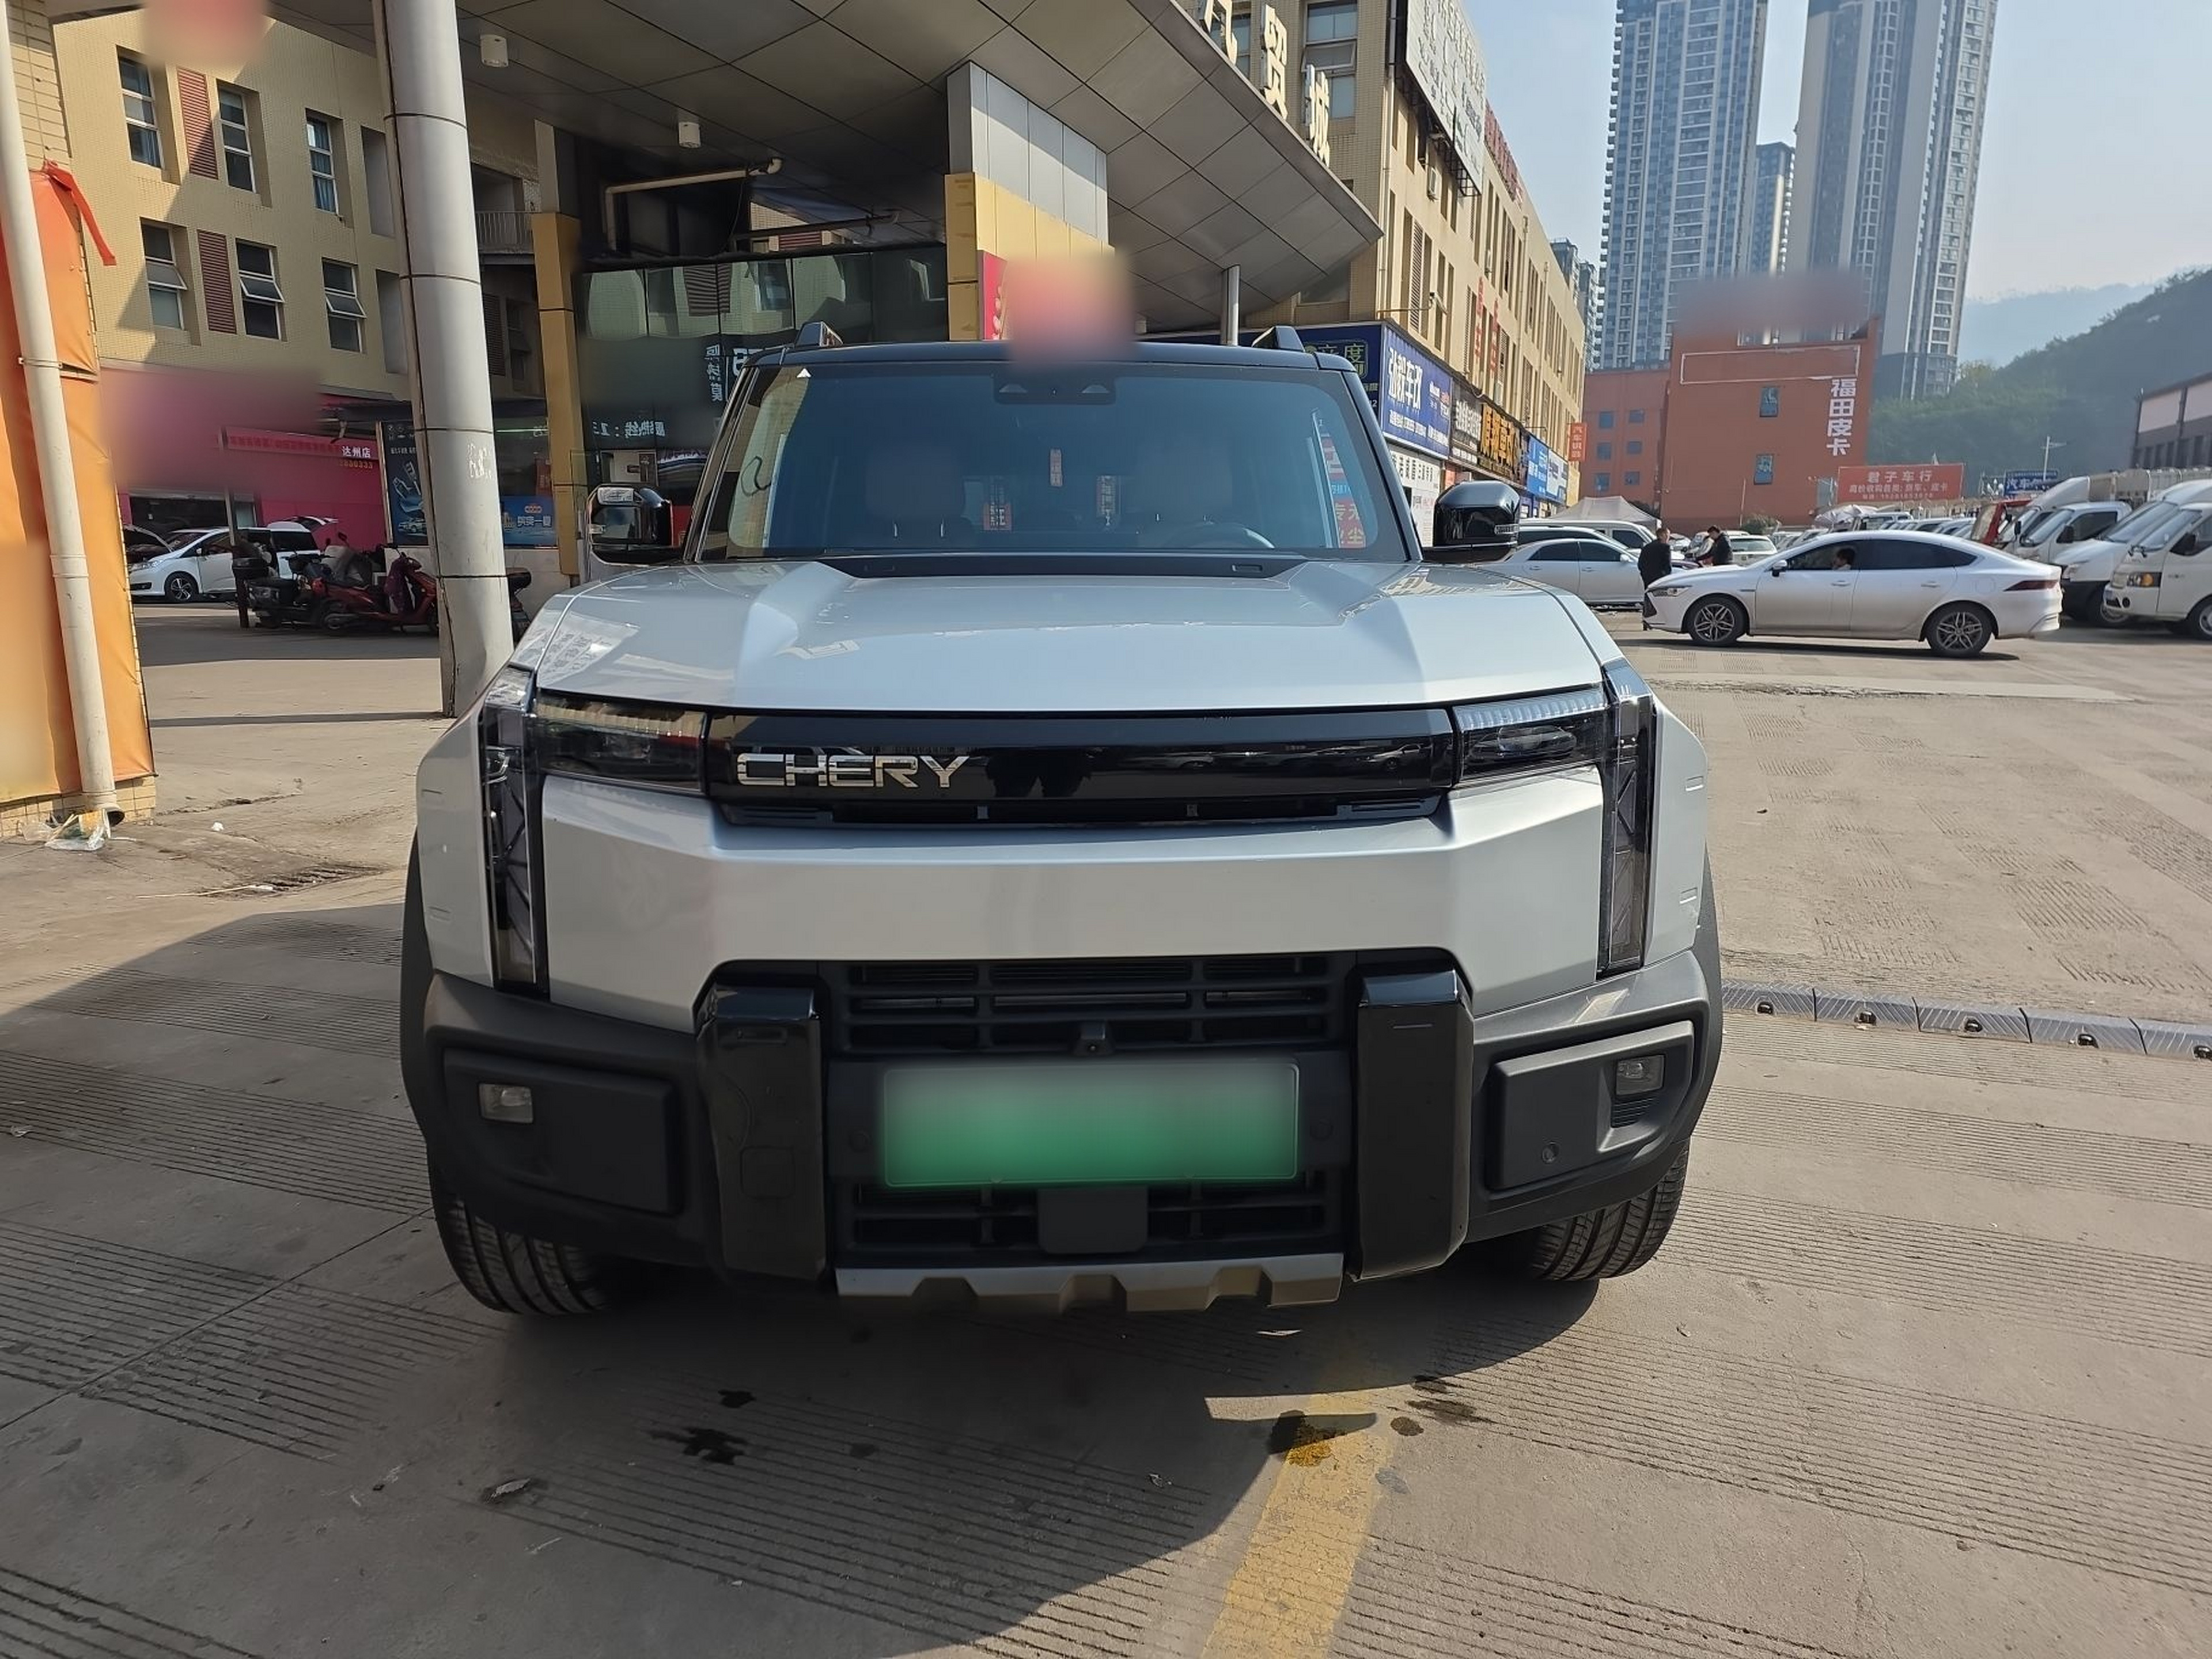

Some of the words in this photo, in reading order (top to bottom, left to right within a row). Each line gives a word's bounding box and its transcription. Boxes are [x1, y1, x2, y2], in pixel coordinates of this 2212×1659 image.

[1826, 378, 1857, 456] 福田皮卡
[342, 446, 370, 457] 达州店
[1867, 471, 1933, 483] 君子车行
[737, 753, 970, 787] CHERY
